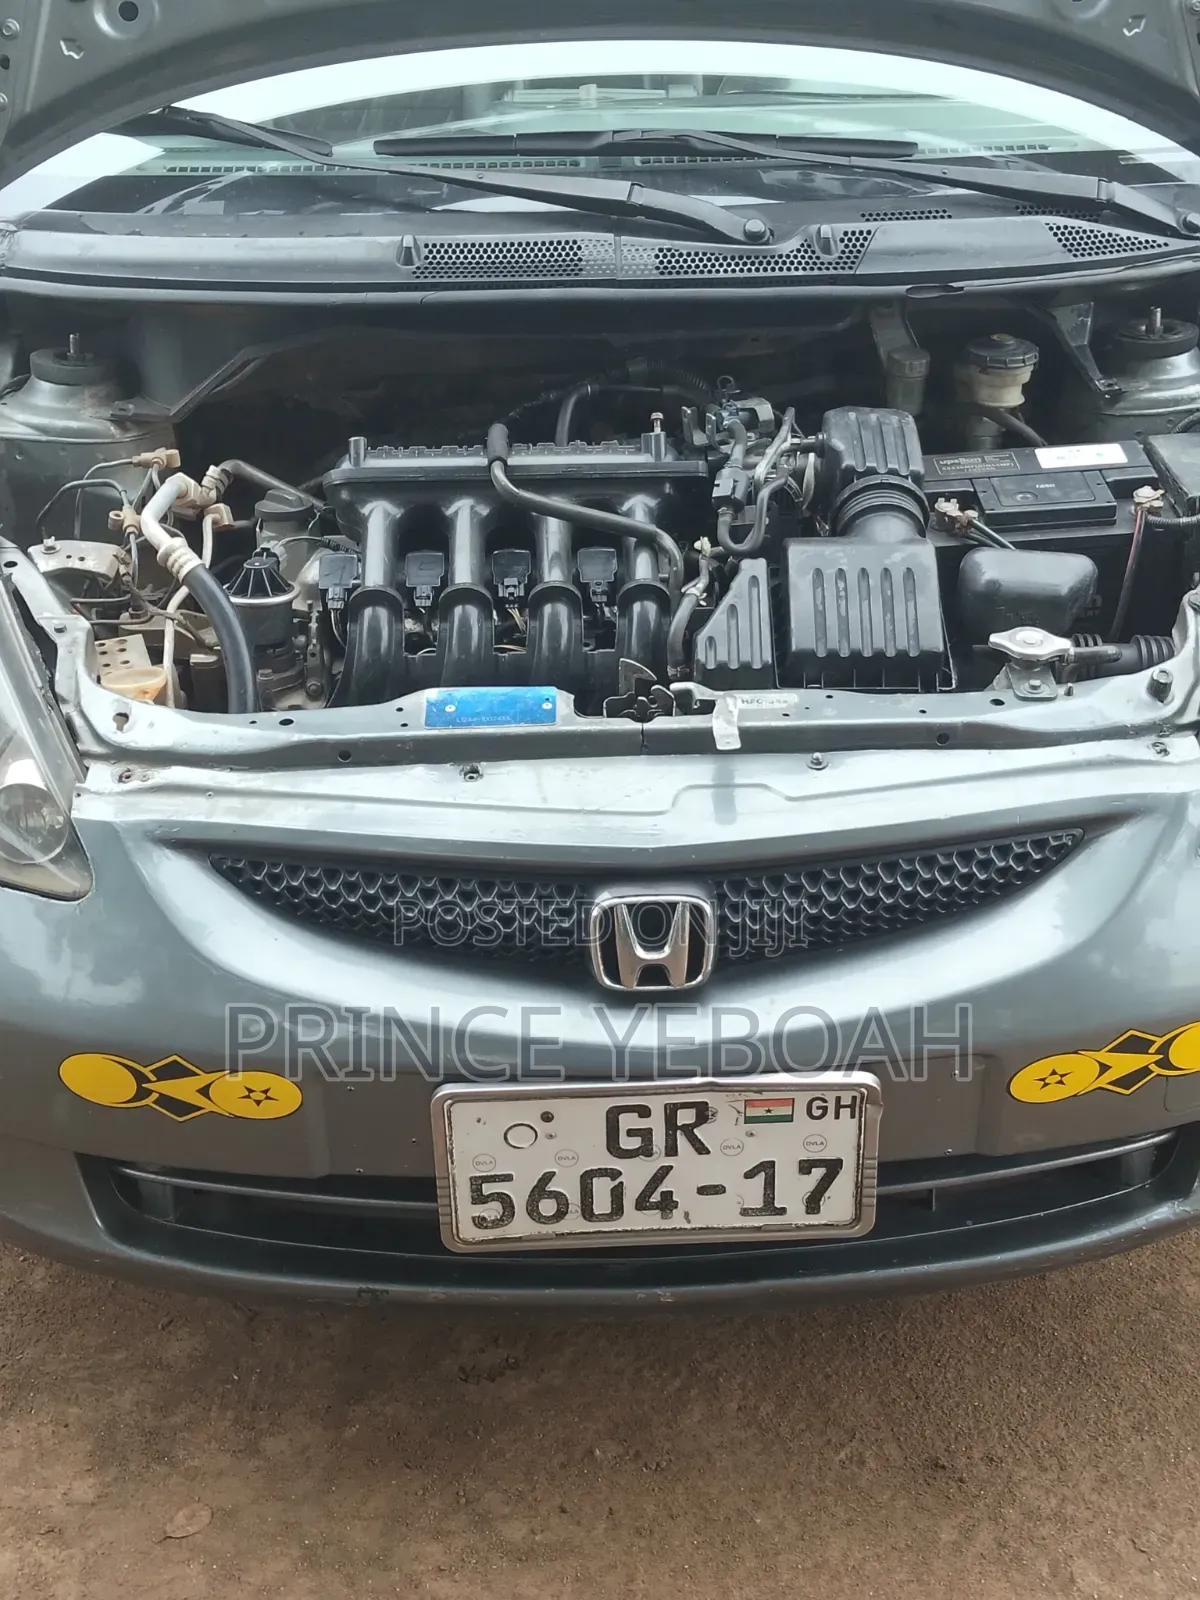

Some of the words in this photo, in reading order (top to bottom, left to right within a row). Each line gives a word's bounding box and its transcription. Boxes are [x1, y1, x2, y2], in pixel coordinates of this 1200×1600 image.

[606, 1100, 711, 1158] GR
[805, 1095, 858, 1121] GH
[469, 1158, 844, 1230] 5604-17
